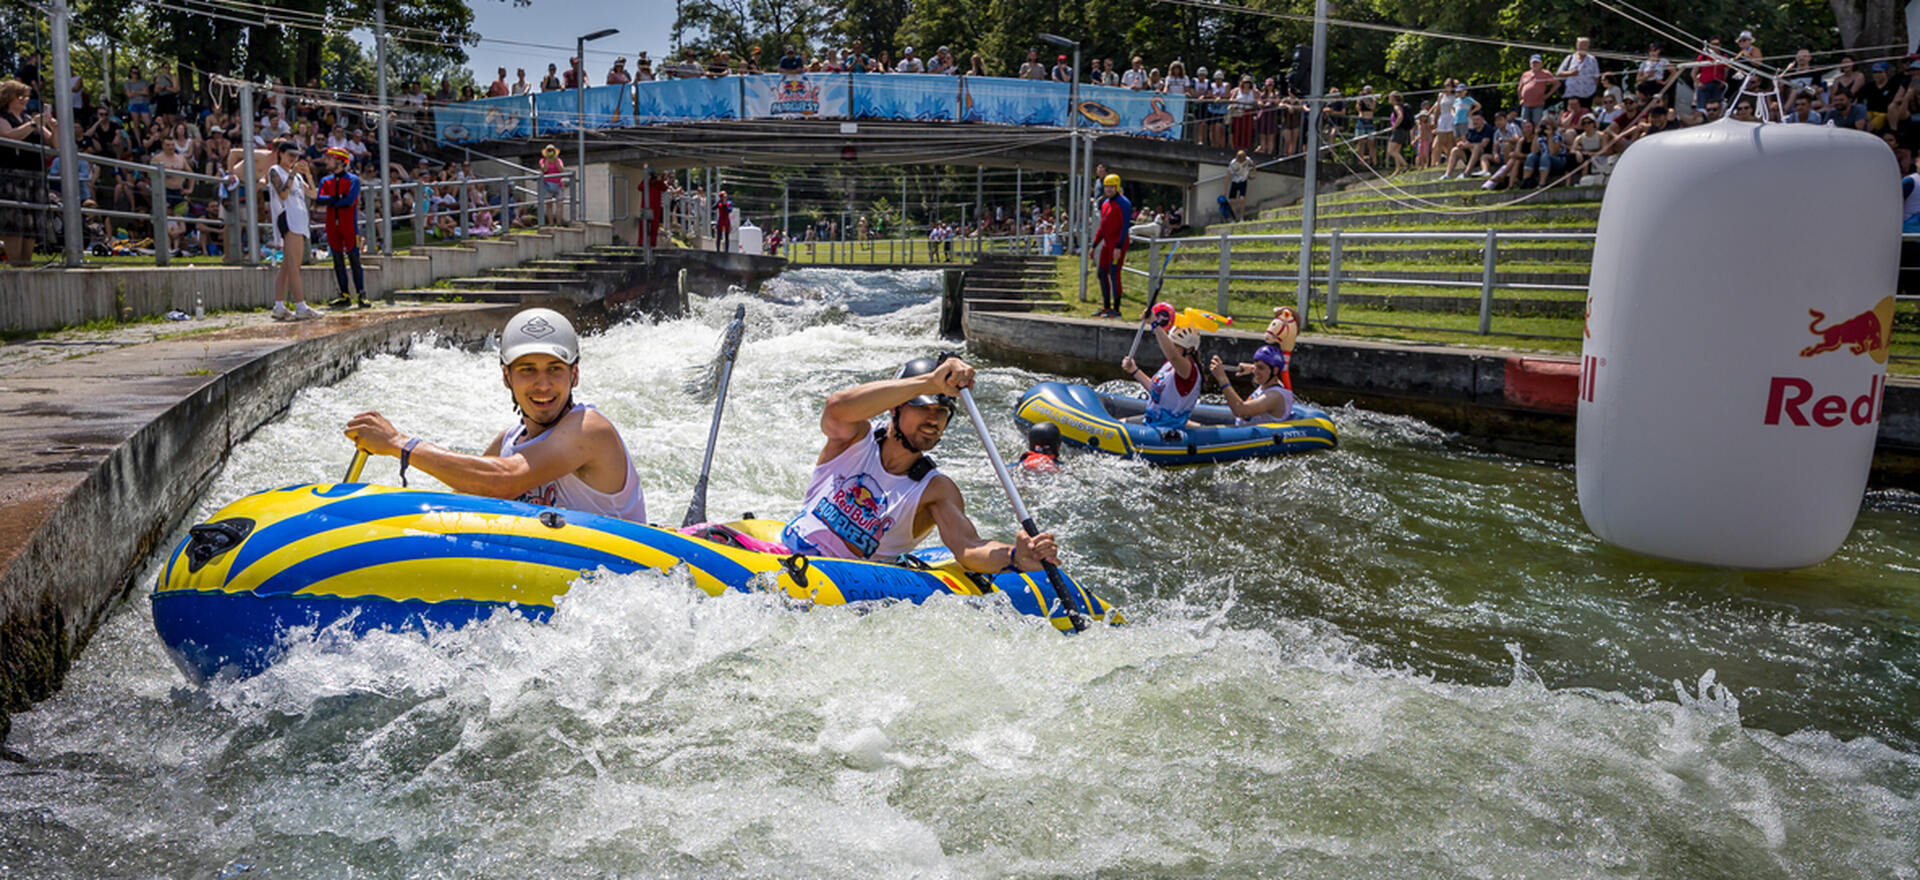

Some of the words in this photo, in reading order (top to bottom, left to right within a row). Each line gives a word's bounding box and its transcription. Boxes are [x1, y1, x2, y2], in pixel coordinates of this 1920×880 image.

[1030, 402, 1104, 437] CHALLENGER
[833, 489, 854, 513] Red
[850, 508, 878, 530] Bull
